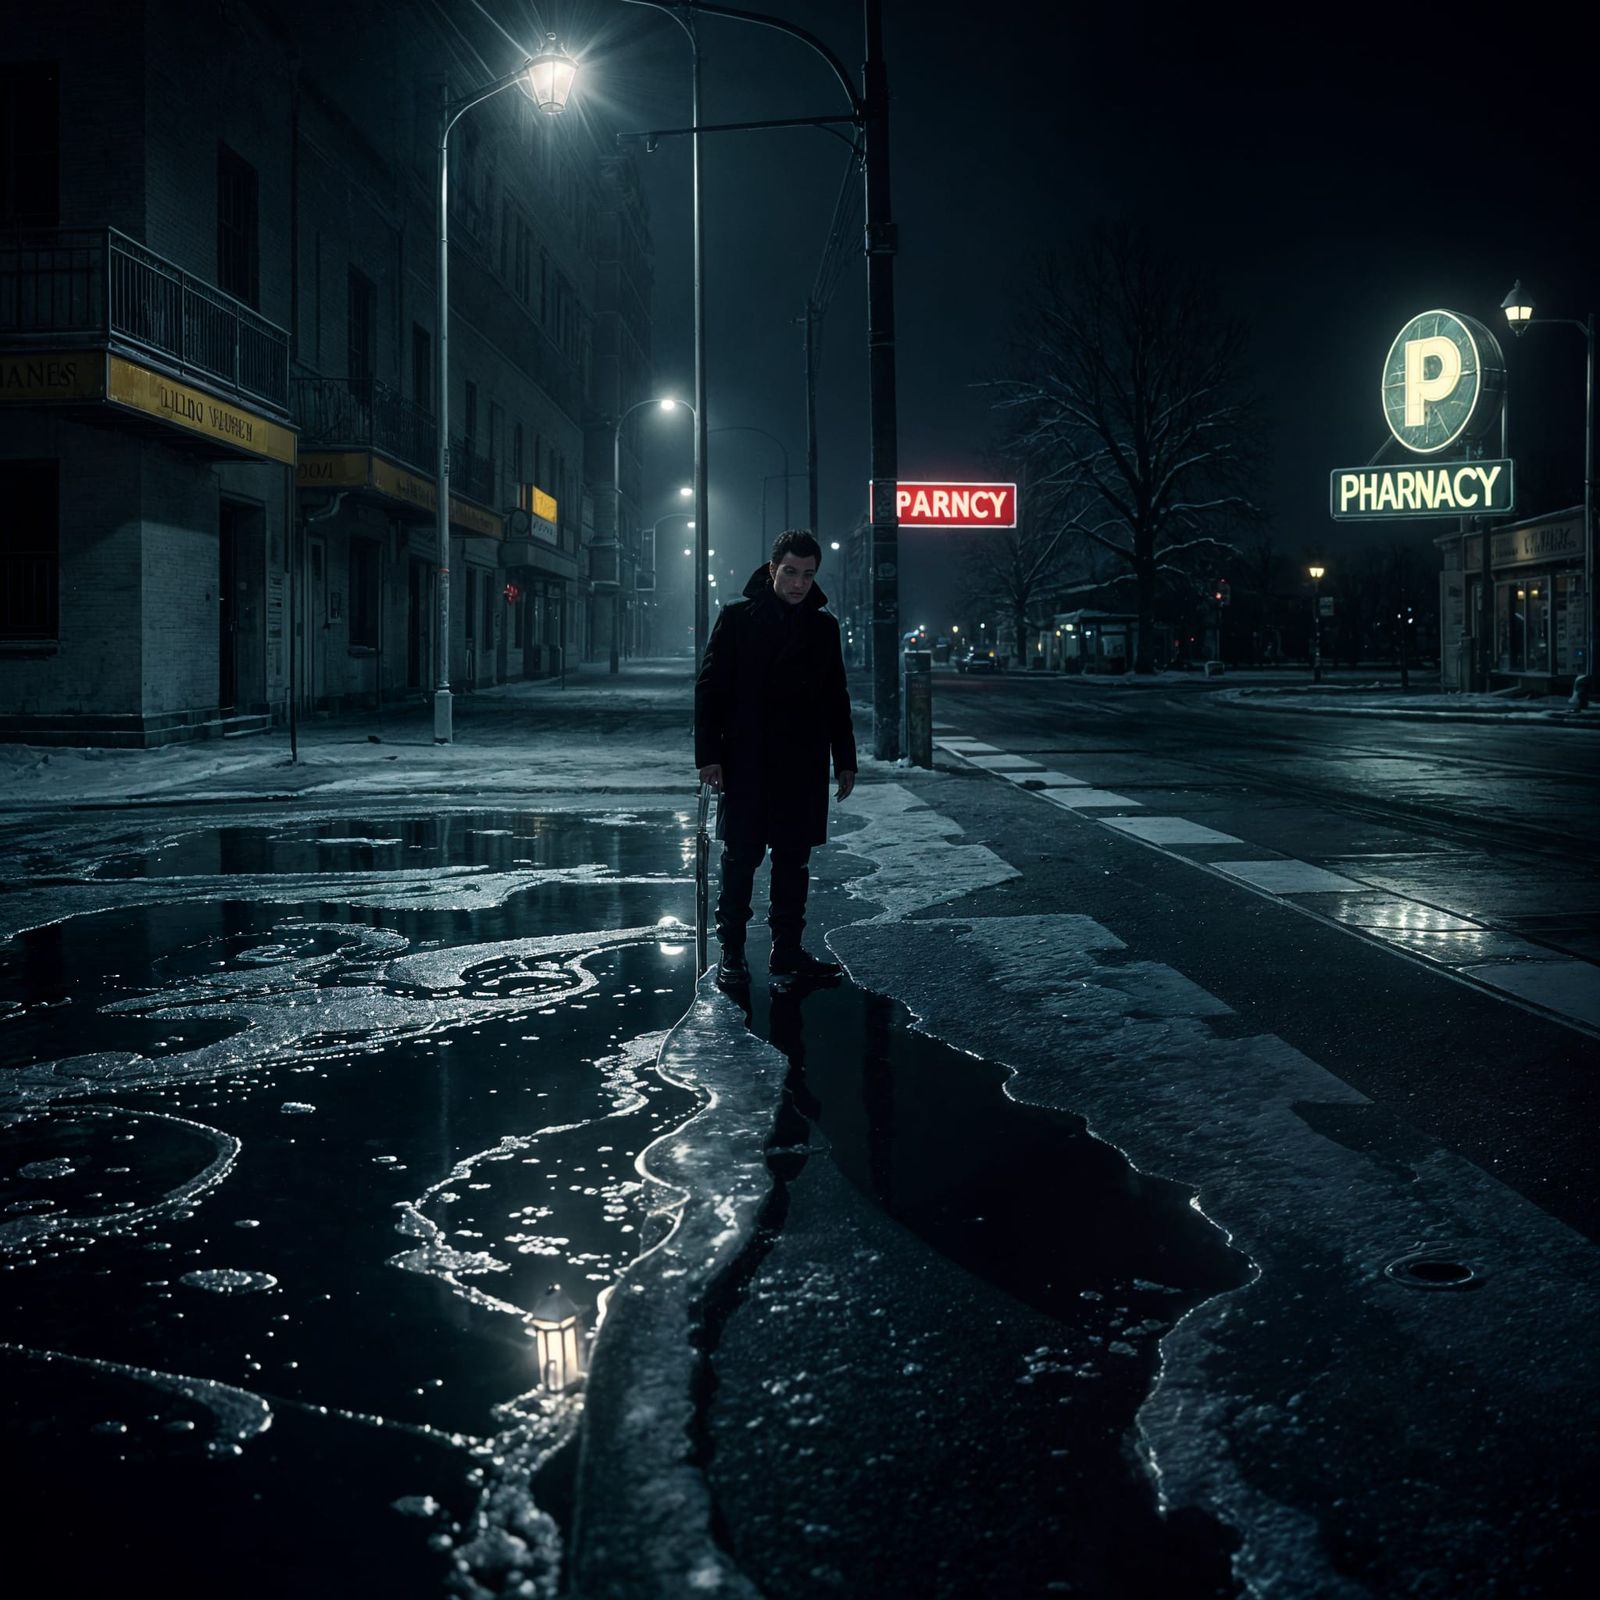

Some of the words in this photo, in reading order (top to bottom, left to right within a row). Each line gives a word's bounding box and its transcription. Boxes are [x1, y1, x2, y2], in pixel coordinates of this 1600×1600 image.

[1405, 336, 1462, 427] P
[896, 490, 1007, 518] PARNCY
[1341, 466, 1502, 512] PHARNACY
